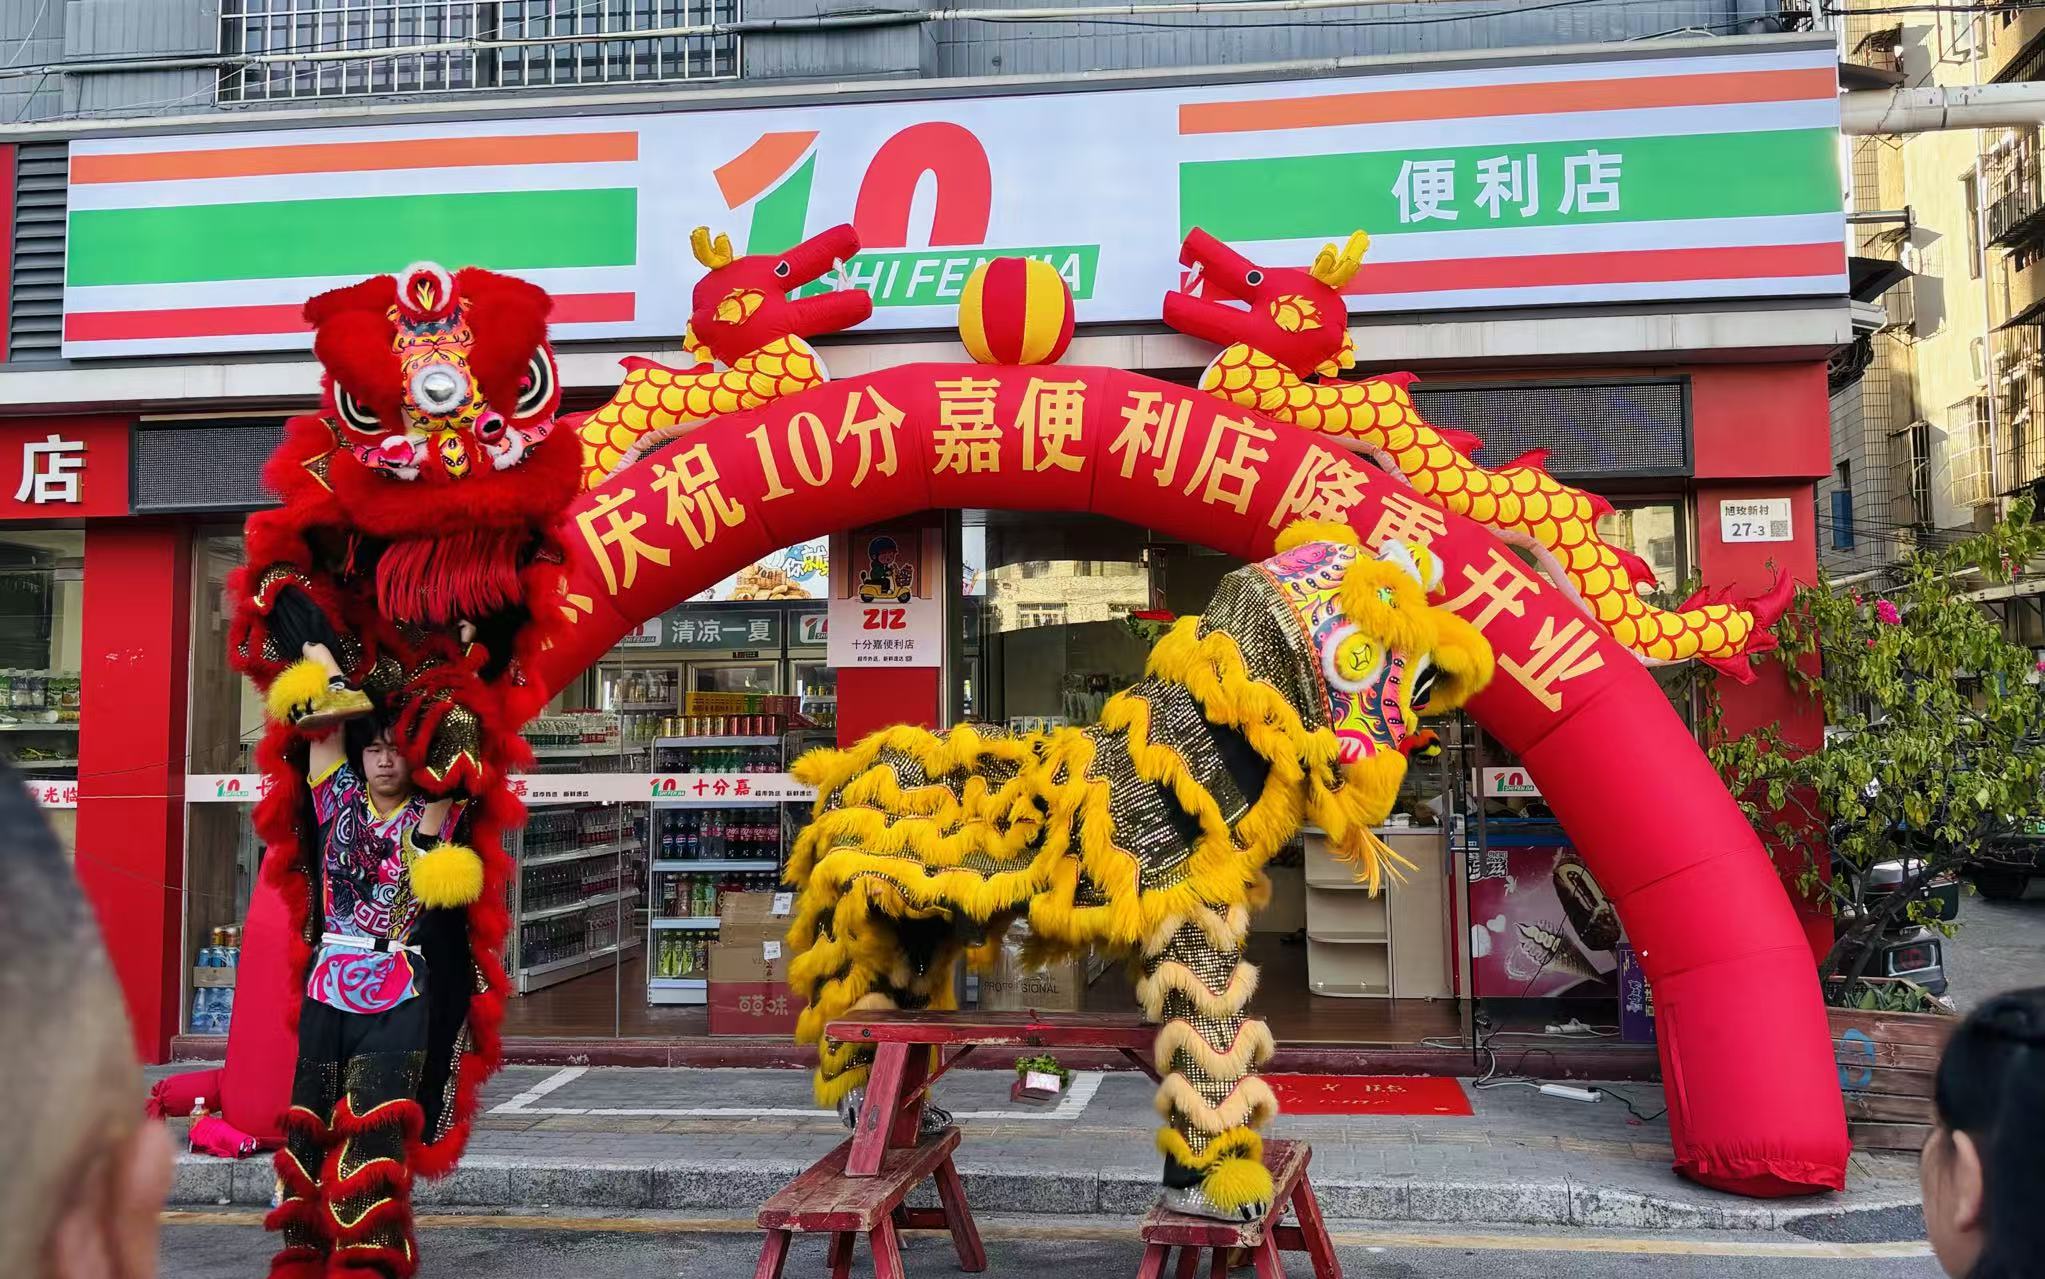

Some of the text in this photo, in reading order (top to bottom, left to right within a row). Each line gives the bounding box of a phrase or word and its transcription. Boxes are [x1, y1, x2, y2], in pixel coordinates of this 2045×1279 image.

[713, 121, 992, 256] 10
[1391, 149, 1623, 224] 便利店
[14, 433, 86, 504] 店
[1731, 522, 1765, 537] 27-3
[863, 608, 907, 630] ZIZ
[671, 619, 771, 643] 清凉一夏
[852, 639, 915, 650] 十分嘉便利店
[692, 778, 752, 796] 十分嘉
[739, 994, 789, 1016] 百草味
